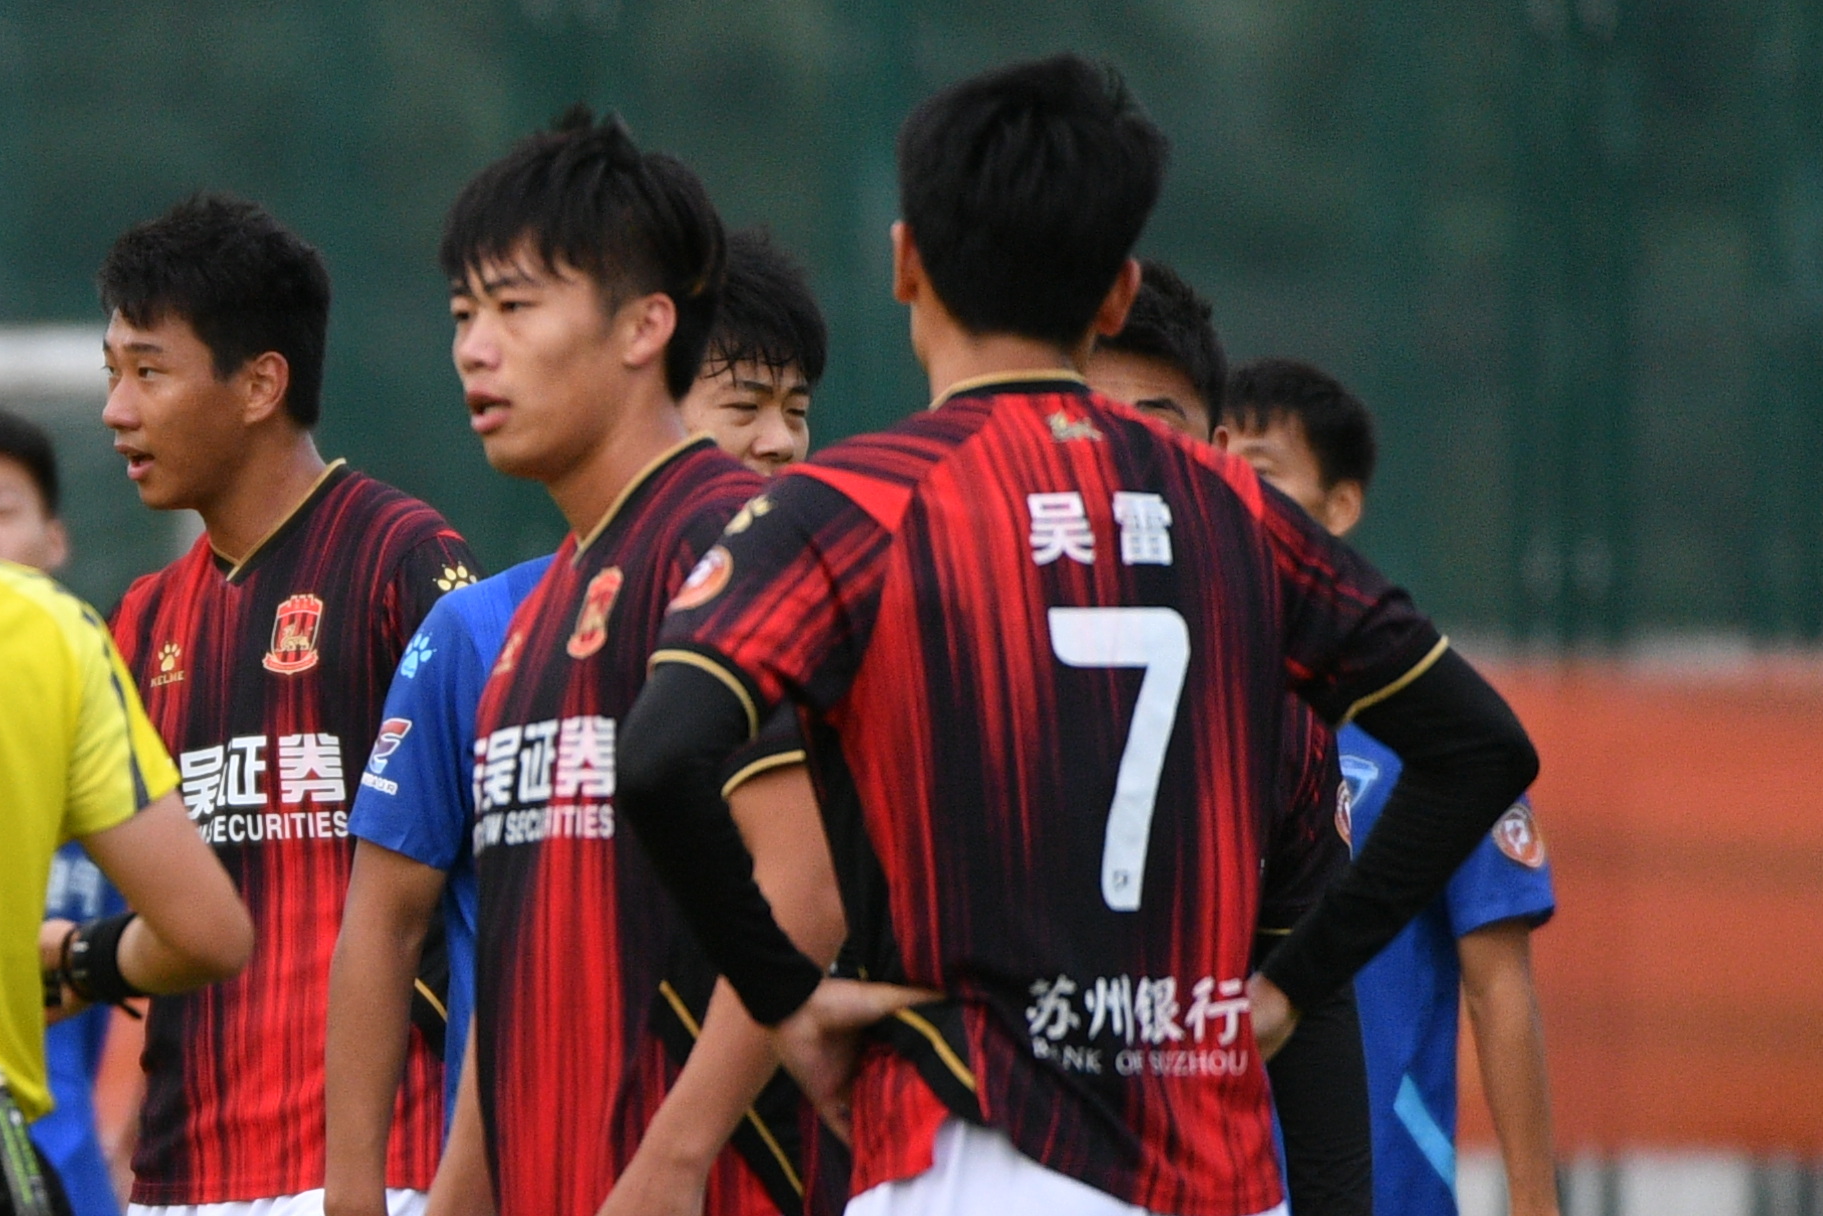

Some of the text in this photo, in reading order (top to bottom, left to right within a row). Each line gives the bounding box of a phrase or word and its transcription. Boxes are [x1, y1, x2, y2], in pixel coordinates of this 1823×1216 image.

[1027, 491, 1173, 566] 吴雷
[150, 670, 186, 687] KELME
[179, 733, 345, 820] 吴证券
[1048, 606, 1191, 911] 7
[1026, 973, 1251, 1046] 苏州银行
